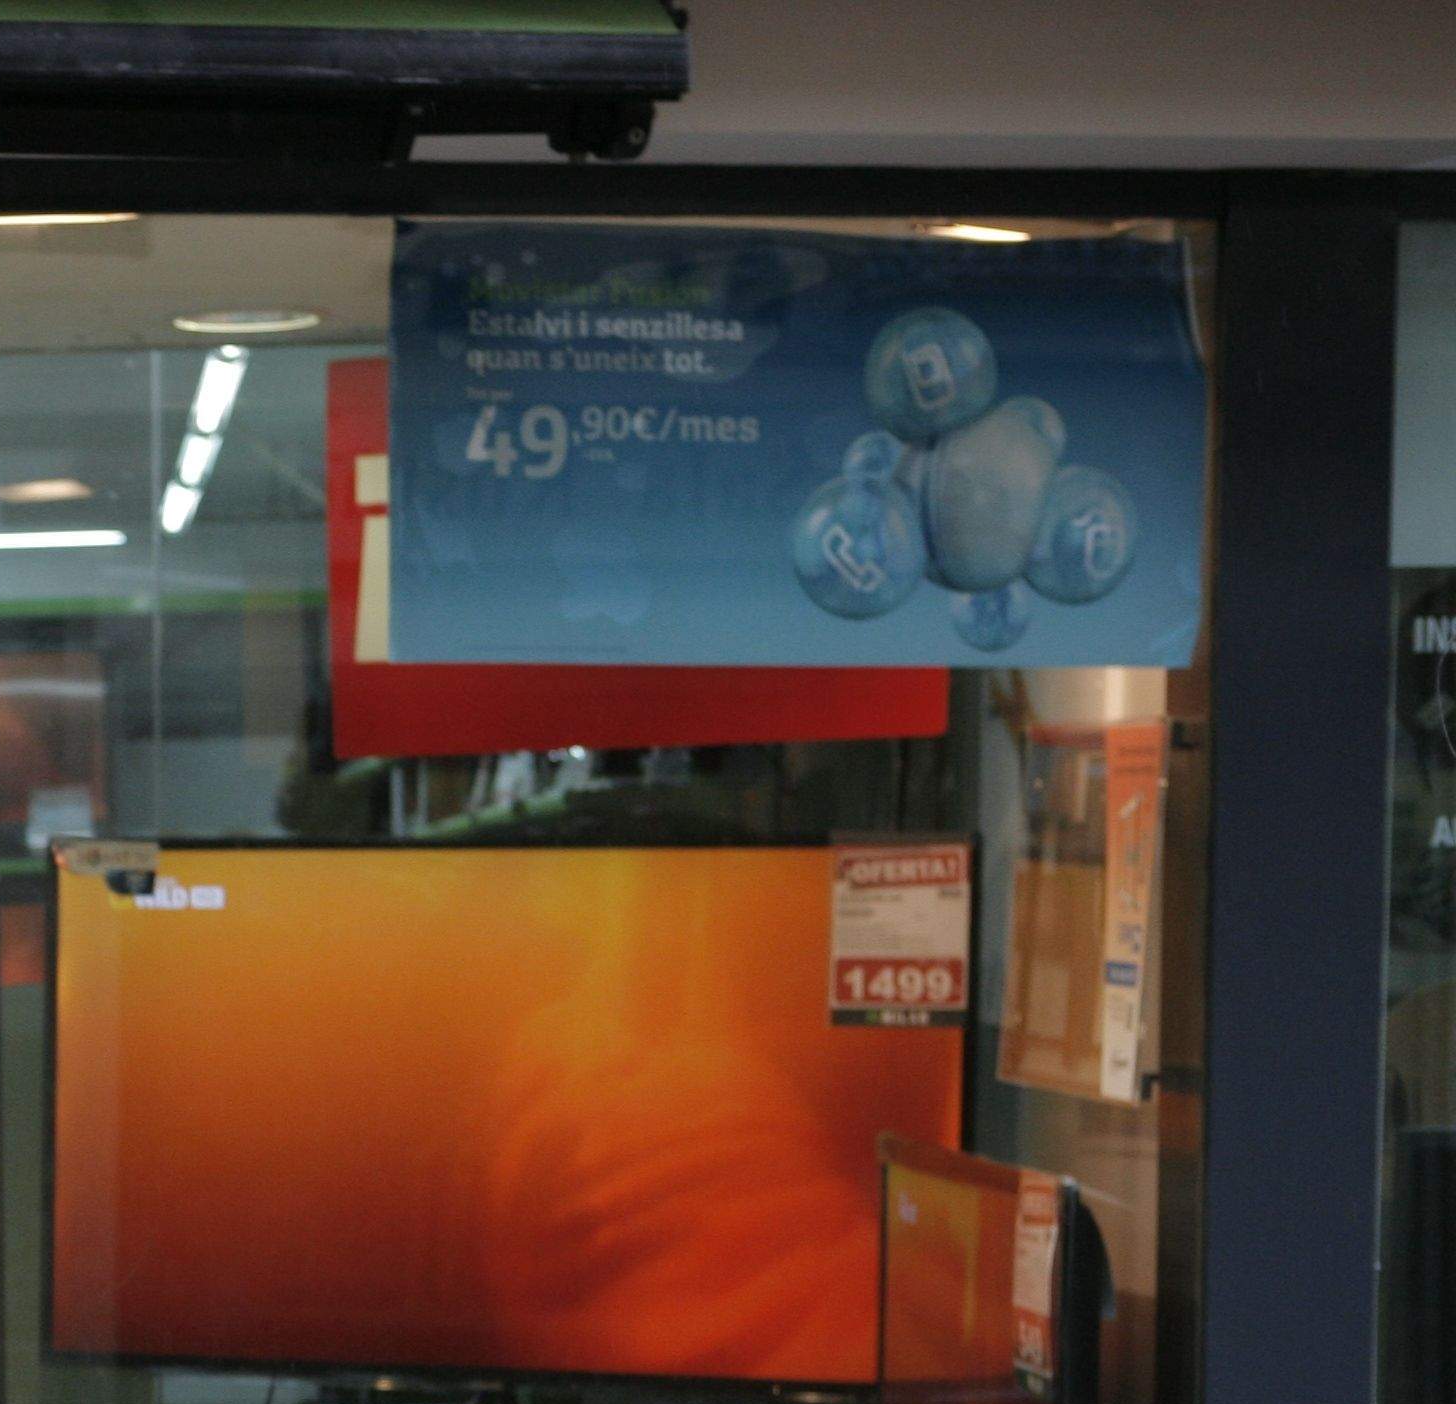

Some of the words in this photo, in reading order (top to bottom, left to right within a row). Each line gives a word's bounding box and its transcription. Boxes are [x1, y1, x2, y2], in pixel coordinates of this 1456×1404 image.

[468, 310, 573, 339] Estalvi
[578, 312, 588, 338] i
[593, 312, 745, 342] senzillesa
[465, 350, 539, 376] quan
[549, 347, 656, 372] s'uneix
[844, 966, 954, 1002] 1499
